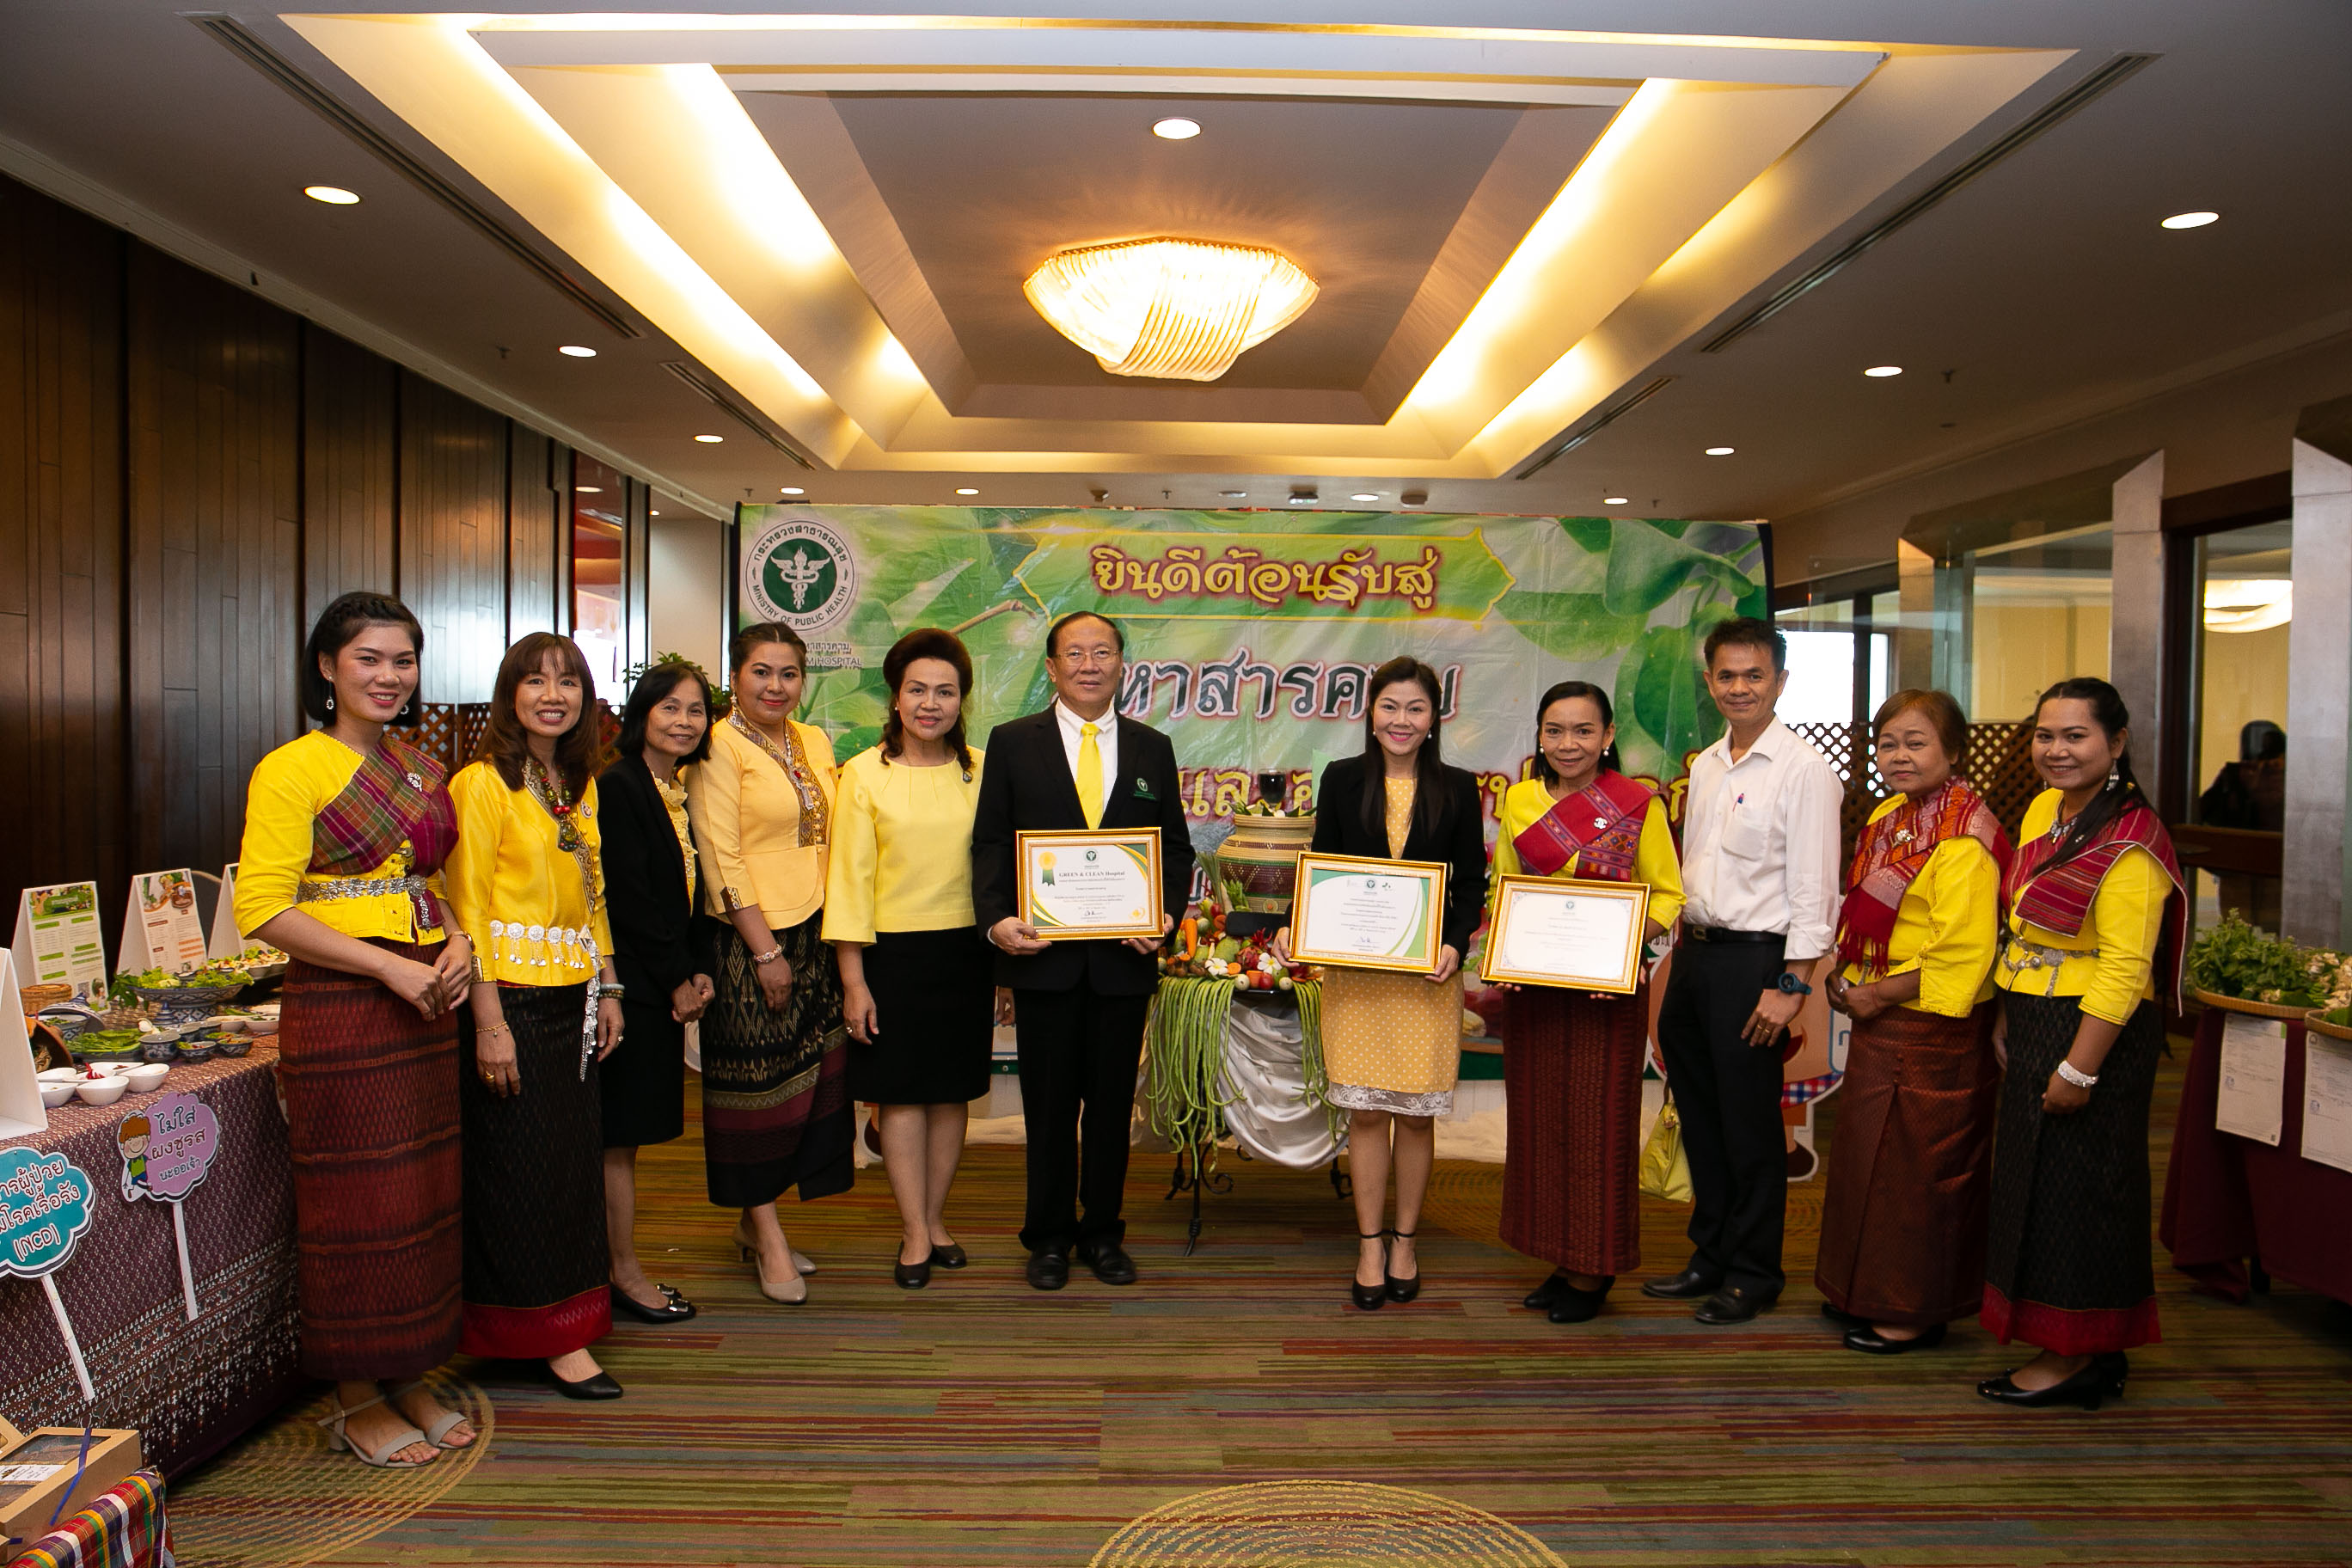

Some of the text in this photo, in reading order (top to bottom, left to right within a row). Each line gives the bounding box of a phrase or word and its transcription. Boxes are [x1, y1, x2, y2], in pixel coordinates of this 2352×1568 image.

[1092, 547, 1439, 609] ยินดีต้อนรับสู่
[752, 584, 848, 626] MINISTRY OF PUBLIC HEALTH
[818, 656, 862, 666] HOSPITAL
[154, 1105, 196, 1134] ไม่ใส่
[151, 1128, 206, 1160] ผงชูรส
